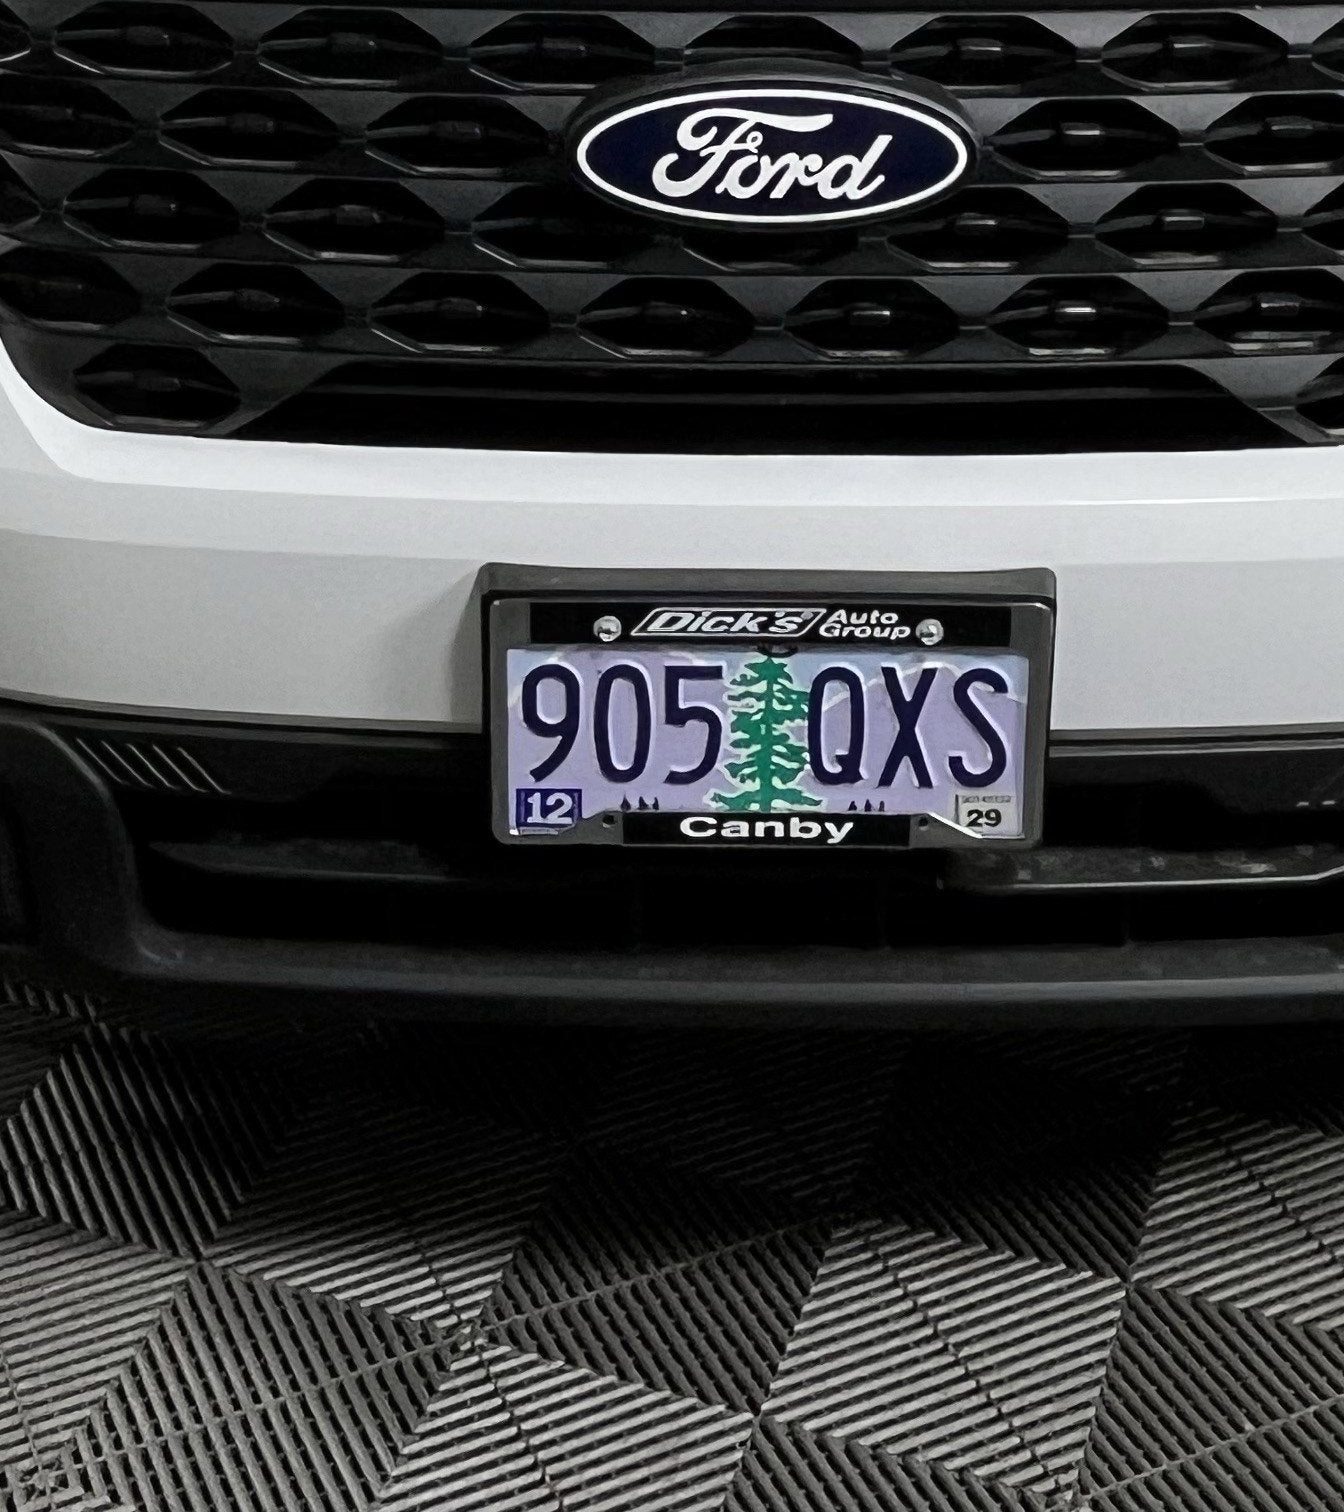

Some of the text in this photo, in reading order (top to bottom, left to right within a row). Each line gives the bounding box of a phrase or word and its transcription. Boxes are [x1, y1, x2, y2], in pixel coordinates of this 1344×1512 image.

[652, 107, 893, 201] Ford
[647, 610, 804, 634] Dick's
[826, 608, 899, 625] Auto
[818, 623, 912, 640] Group
[520, 662, 1009, 788] 905 QXS
[526, 791, 573, 826] 12
[965, 808, 1002, 828] 29
[679, 814, 855, 845] Canby
